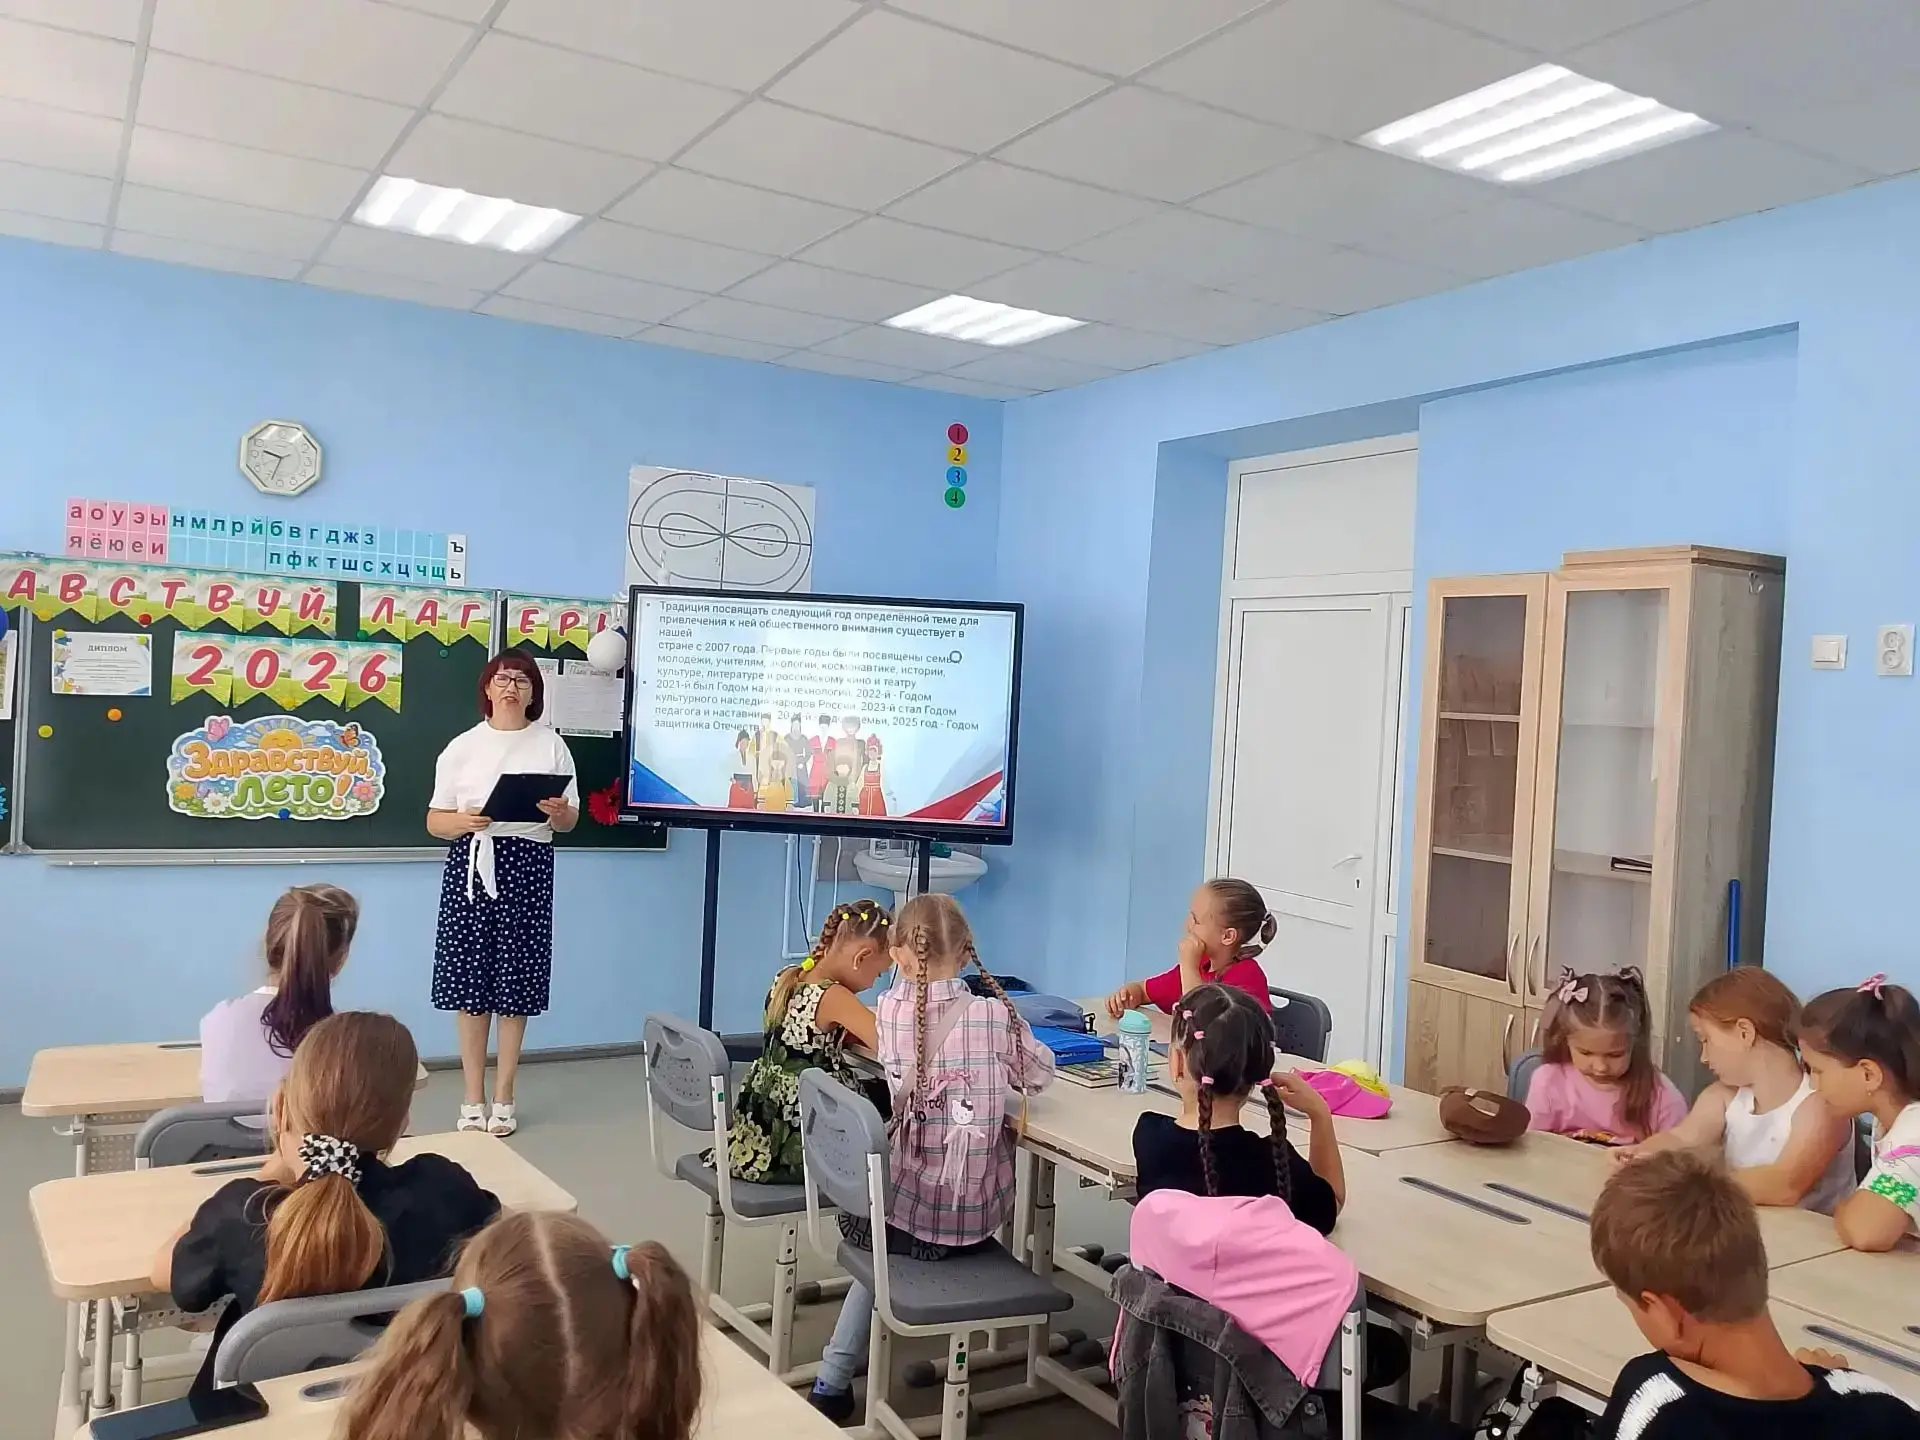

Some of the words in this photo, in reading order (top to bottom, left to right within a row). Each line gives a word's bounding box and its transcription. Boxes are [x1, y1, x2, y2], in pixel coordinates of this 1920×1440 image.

[953, 447, 962, 462] 2
[952, 469, 961, 484] 3
[950, 491, 959, 504] 4
[660, 601, 710, 613] Традиция
[712, 605, 768, 617] посвящать
[771, 607, 832, 619] следующий
[834, 611, 852, 620] год
[854, 612, 930, 624] определённой
[932, 615, 957, 625] теме
[959, 617, 979, 626] для
[659, 615, 727, 627] привлечения
[738, 618, 757, 628] ней
[759, 620, 839, 631] общественного
[841, 624, 894, 634] внимания
[896, 627, 957, 639] существует
[659, 628, 692, 638] нашей
[658, 642, 694, 652] стране
[705, 642, 730, 652] 2007
[804, 648, 830, 657] годы
[863, 651, 923, 662] посвящены
[185, 645, 389, 693] 2026
[657, 667, 704, 678] культуре,
[707, 669, 764, 680] литературе
[884, 679, 916, 689] театру
[901, 667, 946, 678] истории,
[656, 679, 691, 689] 2021-й
[693, 680, 714, 690] был
[717, 681, 749, 692] Годом
[856, 689, 891, 699] 2022-й
[899, 690, 932, 702] Годом
[655, 693, 718, 704] культурного
[861, 701, 896, 712] 2023-й
[898, 705, 922, 714] стал
[924, 704, 957, 716] Годом
[654, 719, 710, 730] защитника
[655, 707, 701, 717] педагога
[857, 716, 890, 727] емьи,
[892, 716, 918, 727] 2025
[920, 720, 938, 729] год
[946, 719, 979, 731] Годом
[184, 741, 374, 778] Здравствуй,
